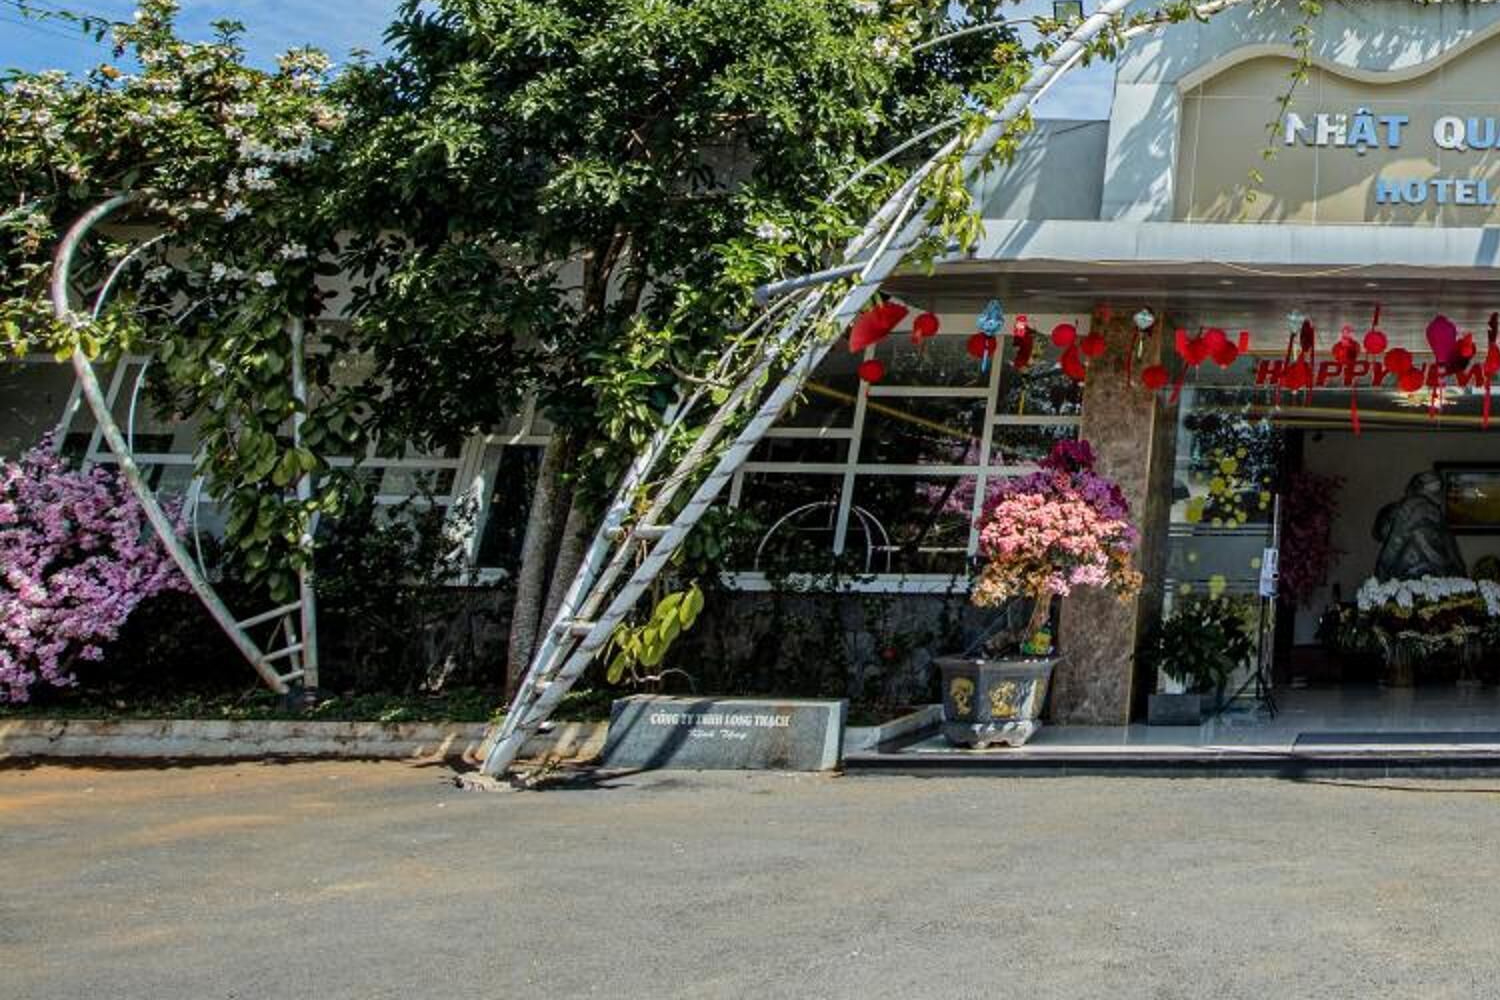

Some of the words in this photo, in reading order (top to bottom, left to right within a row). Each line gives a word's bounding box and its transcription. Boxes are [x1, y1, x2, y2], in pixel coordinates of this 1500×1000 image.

[1284, 107, 1408, 154] NHẬT
[1376, 178, 1497, 205] HOTEL
[1255, 359, 1391, 387] HPPY
[724, 713, 752, 727] LONG
